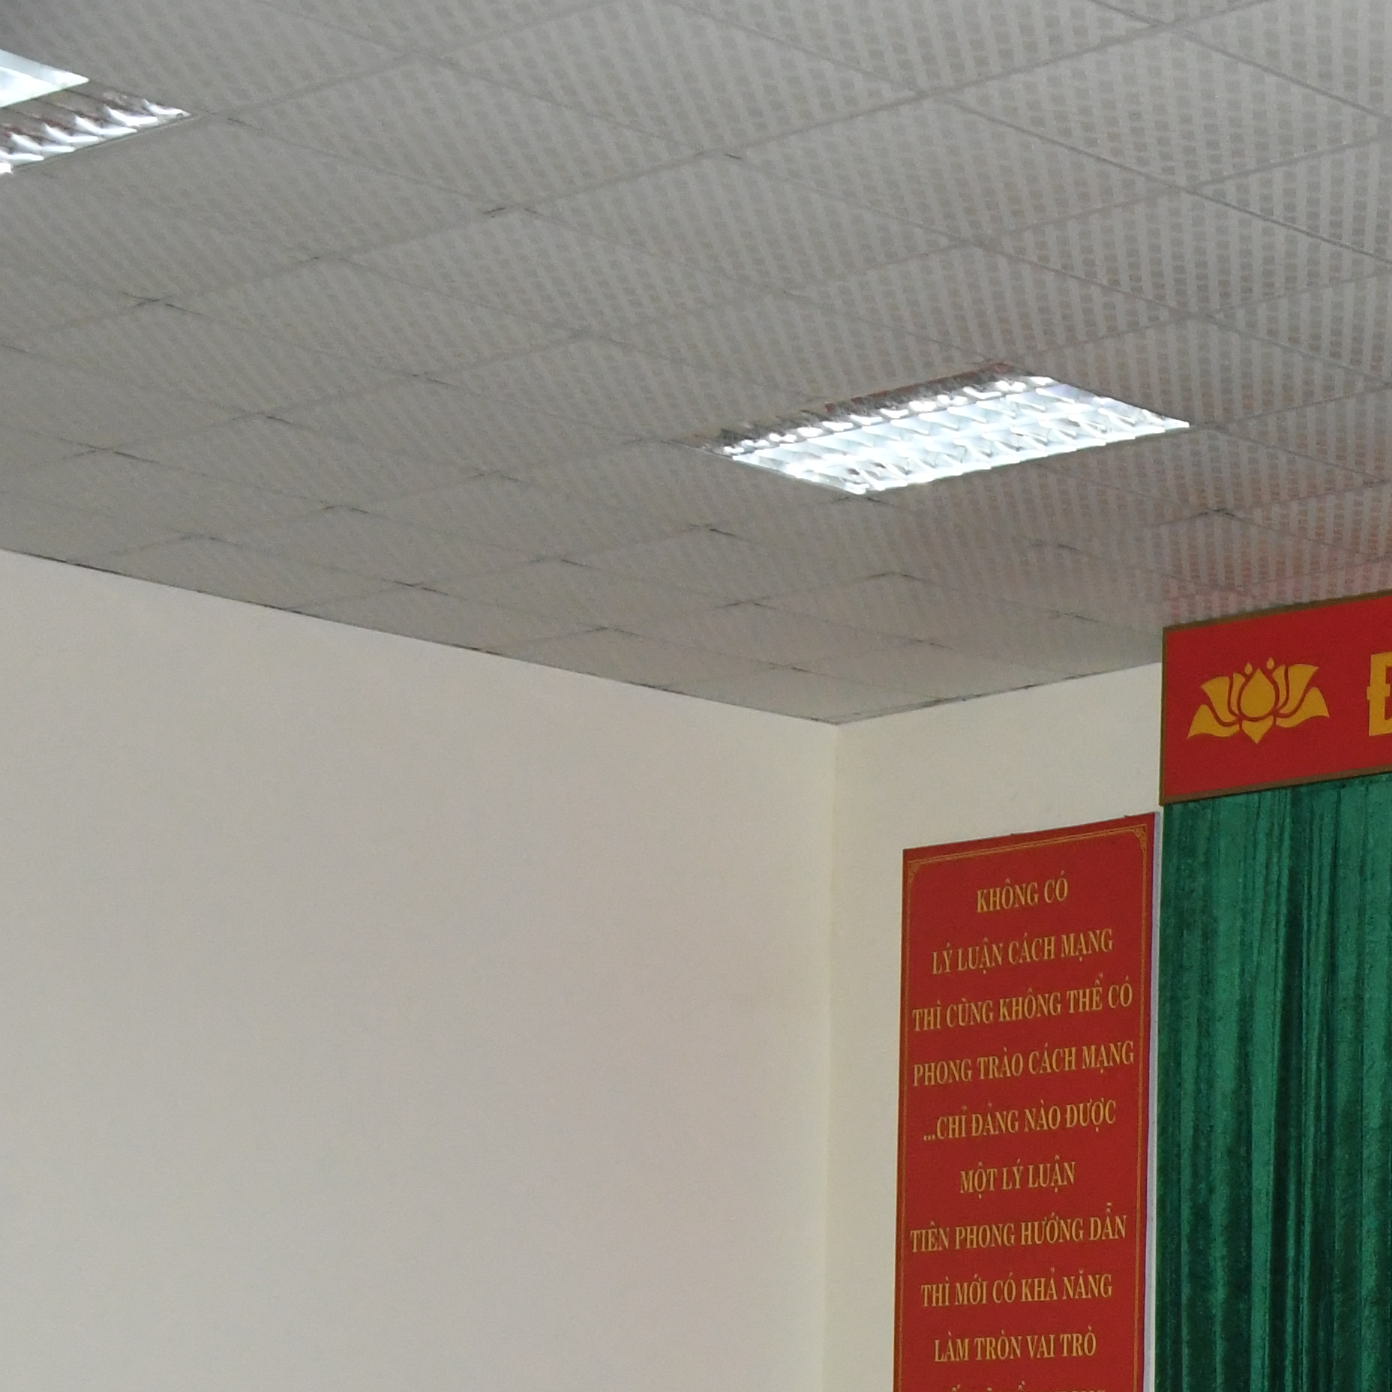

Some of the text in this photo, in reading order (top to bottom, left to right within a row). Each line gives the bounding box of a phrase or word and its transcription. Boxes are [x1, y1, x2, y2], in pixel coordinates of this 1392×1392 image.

[977, 870, 1069, 913] KHÔNG CÓ
[932, 928, 1113, 975] LÝ LUẬN CÁCH MẠNG
[912, 1002, 942, 1032] THÌ
[999, 988, 1062, 1022] KHÔNG
[1066, 972, 1103, 1014] THỂ
[1108, 975, 1133, 1008] CÓ
[913, 1040, 1134, 1087] PHONG TRÀO CÁCH MẠNG
[971, 1102, 1019, 1136] ĐẢNG
[1024, 1099, 1061, 1132] NÀO
[1066, 1097, 1117, 1133] ĐƯỢC
[960, 1154, 1076, 1199] MỘT LÝ LUẬN
[910, 1202, 1127, 1252] TIÊN PHONG HƯỚNG DẪN
[921, 1267, 1113, 1307] THÌ MỚI CÓ KHẢ NĂNG
[934, 1324, 1096, 1362] LÀM TRÒN VAI TRÒ
